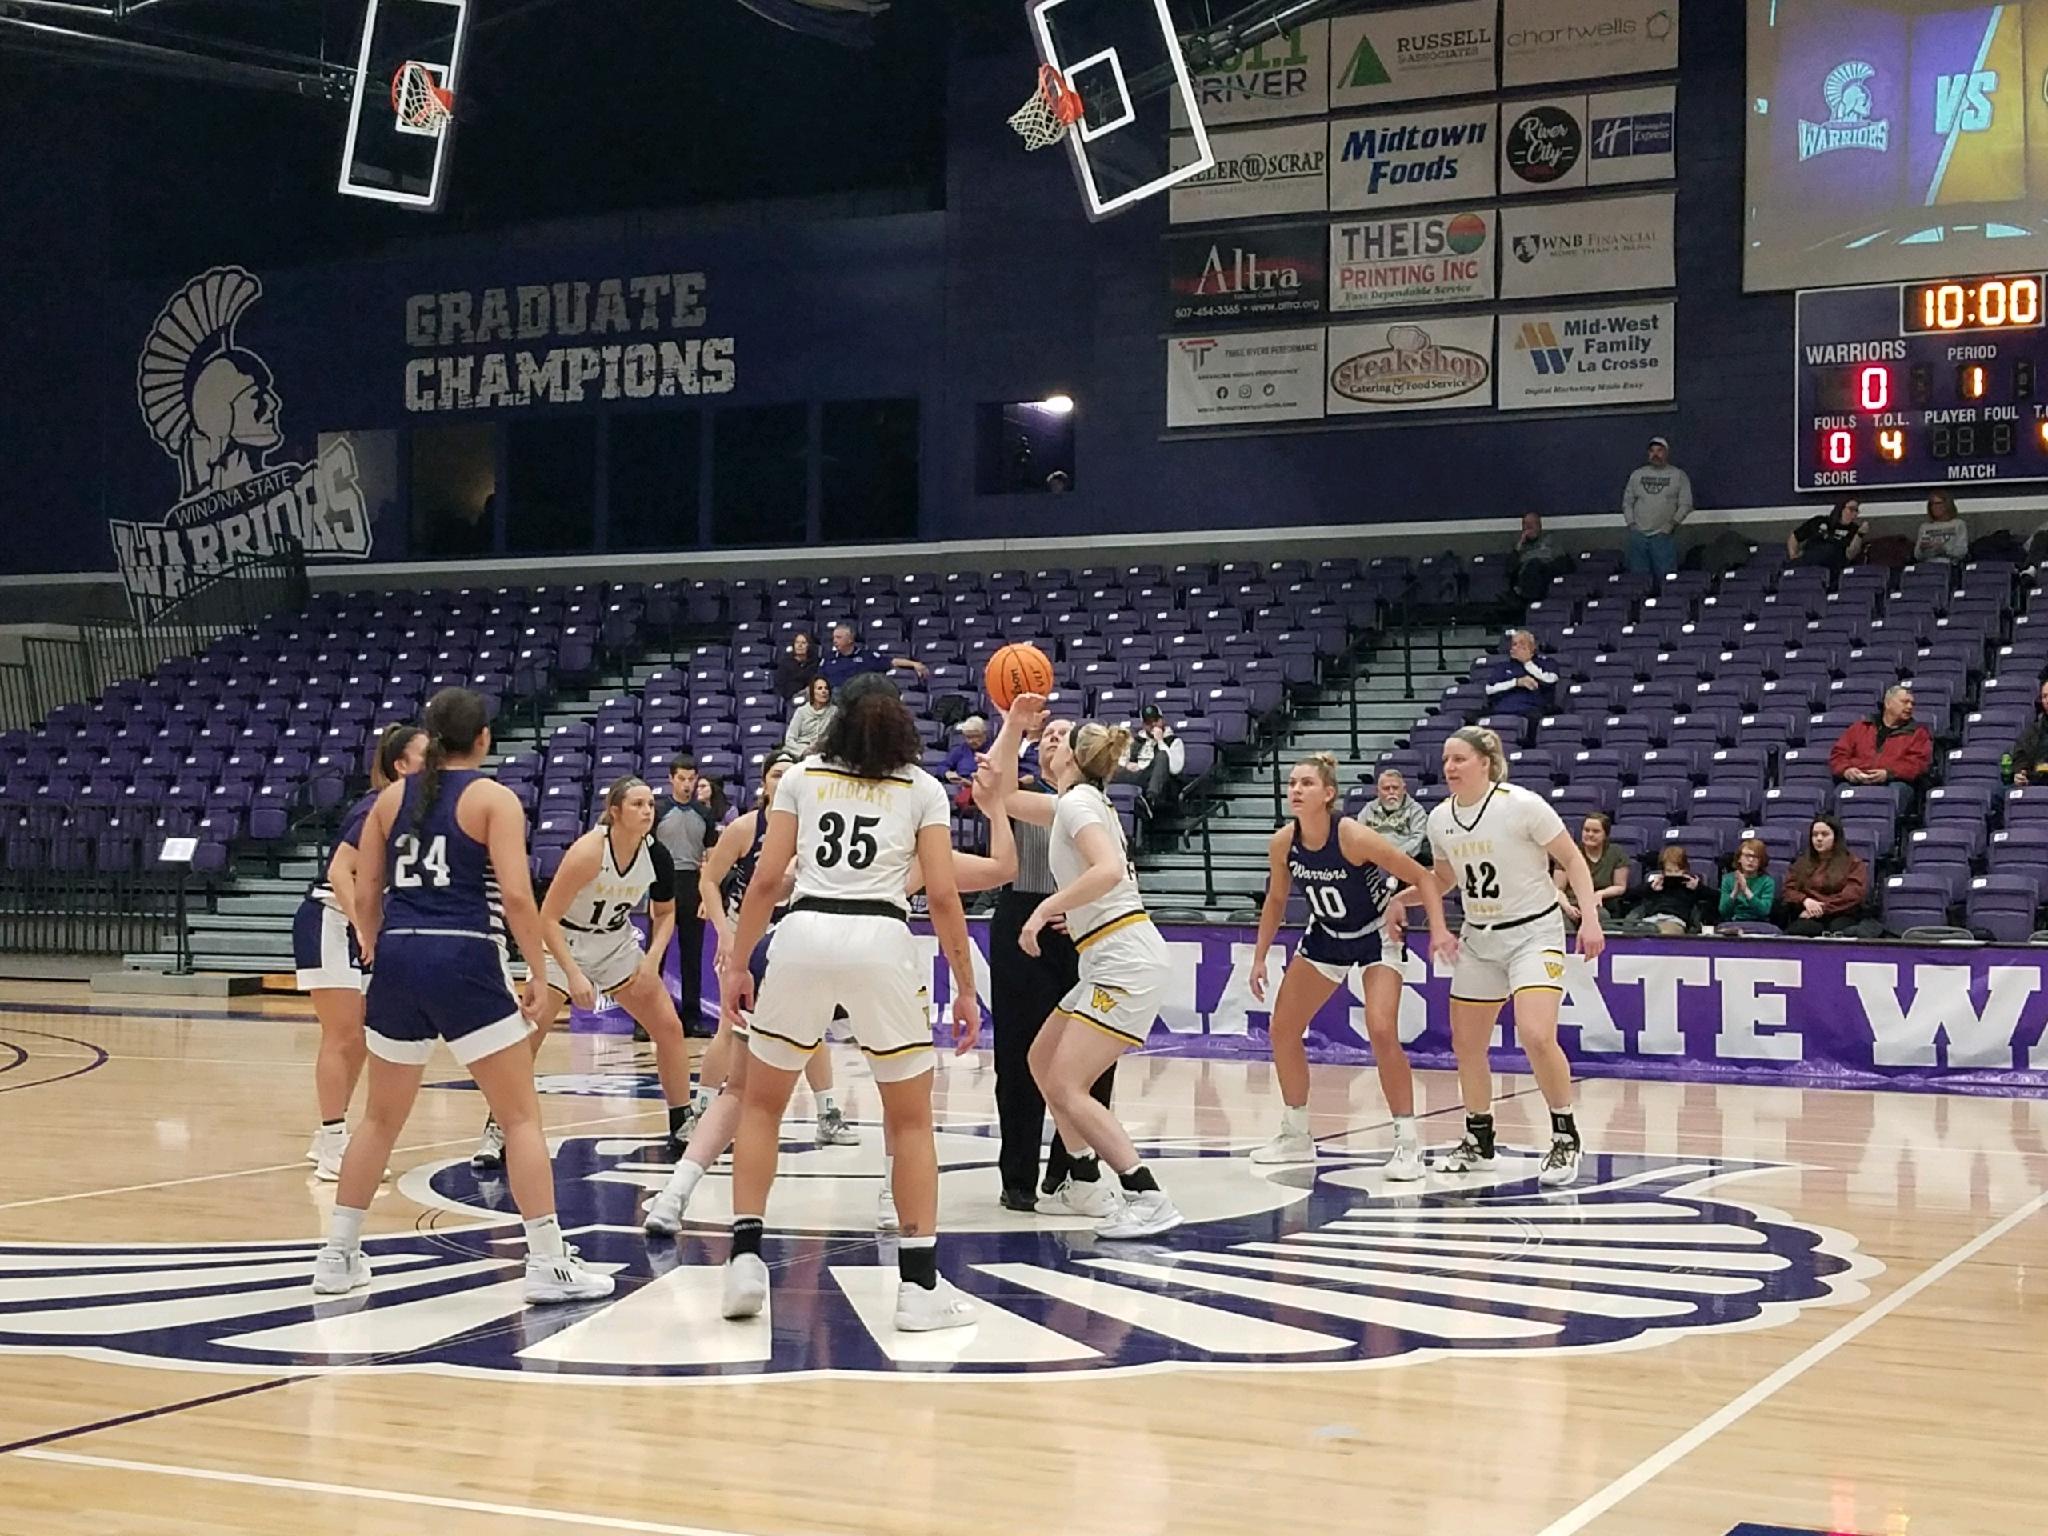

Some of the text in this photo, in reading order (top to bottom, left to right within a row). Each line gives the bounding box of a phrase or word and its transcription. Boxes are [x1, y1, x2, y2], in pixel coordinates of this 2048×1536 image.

[1397, 29, 1491, 53] RUSSELL
[1507, 18, 1637, 47] chartwells
[1203, 67, 1308, 105] RIVER
[1935, 71, 1998, 134] VS
[1341, 122, 1488, 162] Midtown
[1519, 117, 1569, 142] River
[1800, 122, 1888, 160] WARRIORS
[1267, 151, 1324, 175] SCRAP
[1527, 139, 1563, 167] City
[1367, 155, 1458, 194] Foods
[1342, 220, 1444, 261] THEIS
[1543, 233, 1583, 249] WNB
[1195, 245, 1301, 295] Altra
[1341, 260, 1478, 289] PRINTING INC
[405, 272, 706, 346] GRADUATE
[1925, 280, 2037, 328] 10:00
[1564, 314, 1659, 336] Mid-West
[1584, 335, 1651, 354] Family
[1806, 340, 1906, 365] WARRIORS
[1948, 345, 1997, 360] PERIOD
[405, 337, 735, 411] CHAMPIONS
[1577, 357, 1659, 373] La Crosse
[1350, 385, 1391, 393] Catering
[1406, 382, 1430, 390] Food
[1861, 367, 1887, 409] 0
[1973, 367, 1983, 397] 1
[1814, 415, 1857, 429] FOULS
[1873, 412, 1909, 427] T.O.L.
[1925, 405, 2019, 424] PLAYER FOUL
[1830, 432, 1850, 464] 0
[1880, 430, 1902, 460] 4
[1814, 470, 1857, 486] SCORE
[1948, 465, 1996, 479] MATCH
[175, 470, 294, 527] WINONA STATE
[815, 811, 881, 870] 35
[394, 833, 451, 888] 24
[1289, 861, 1348, 881] Warriors
[1465, 861, 1500, 899] 42
[590, 900, 633, 927] 12
[1305, 885, 1347, 918] 10
